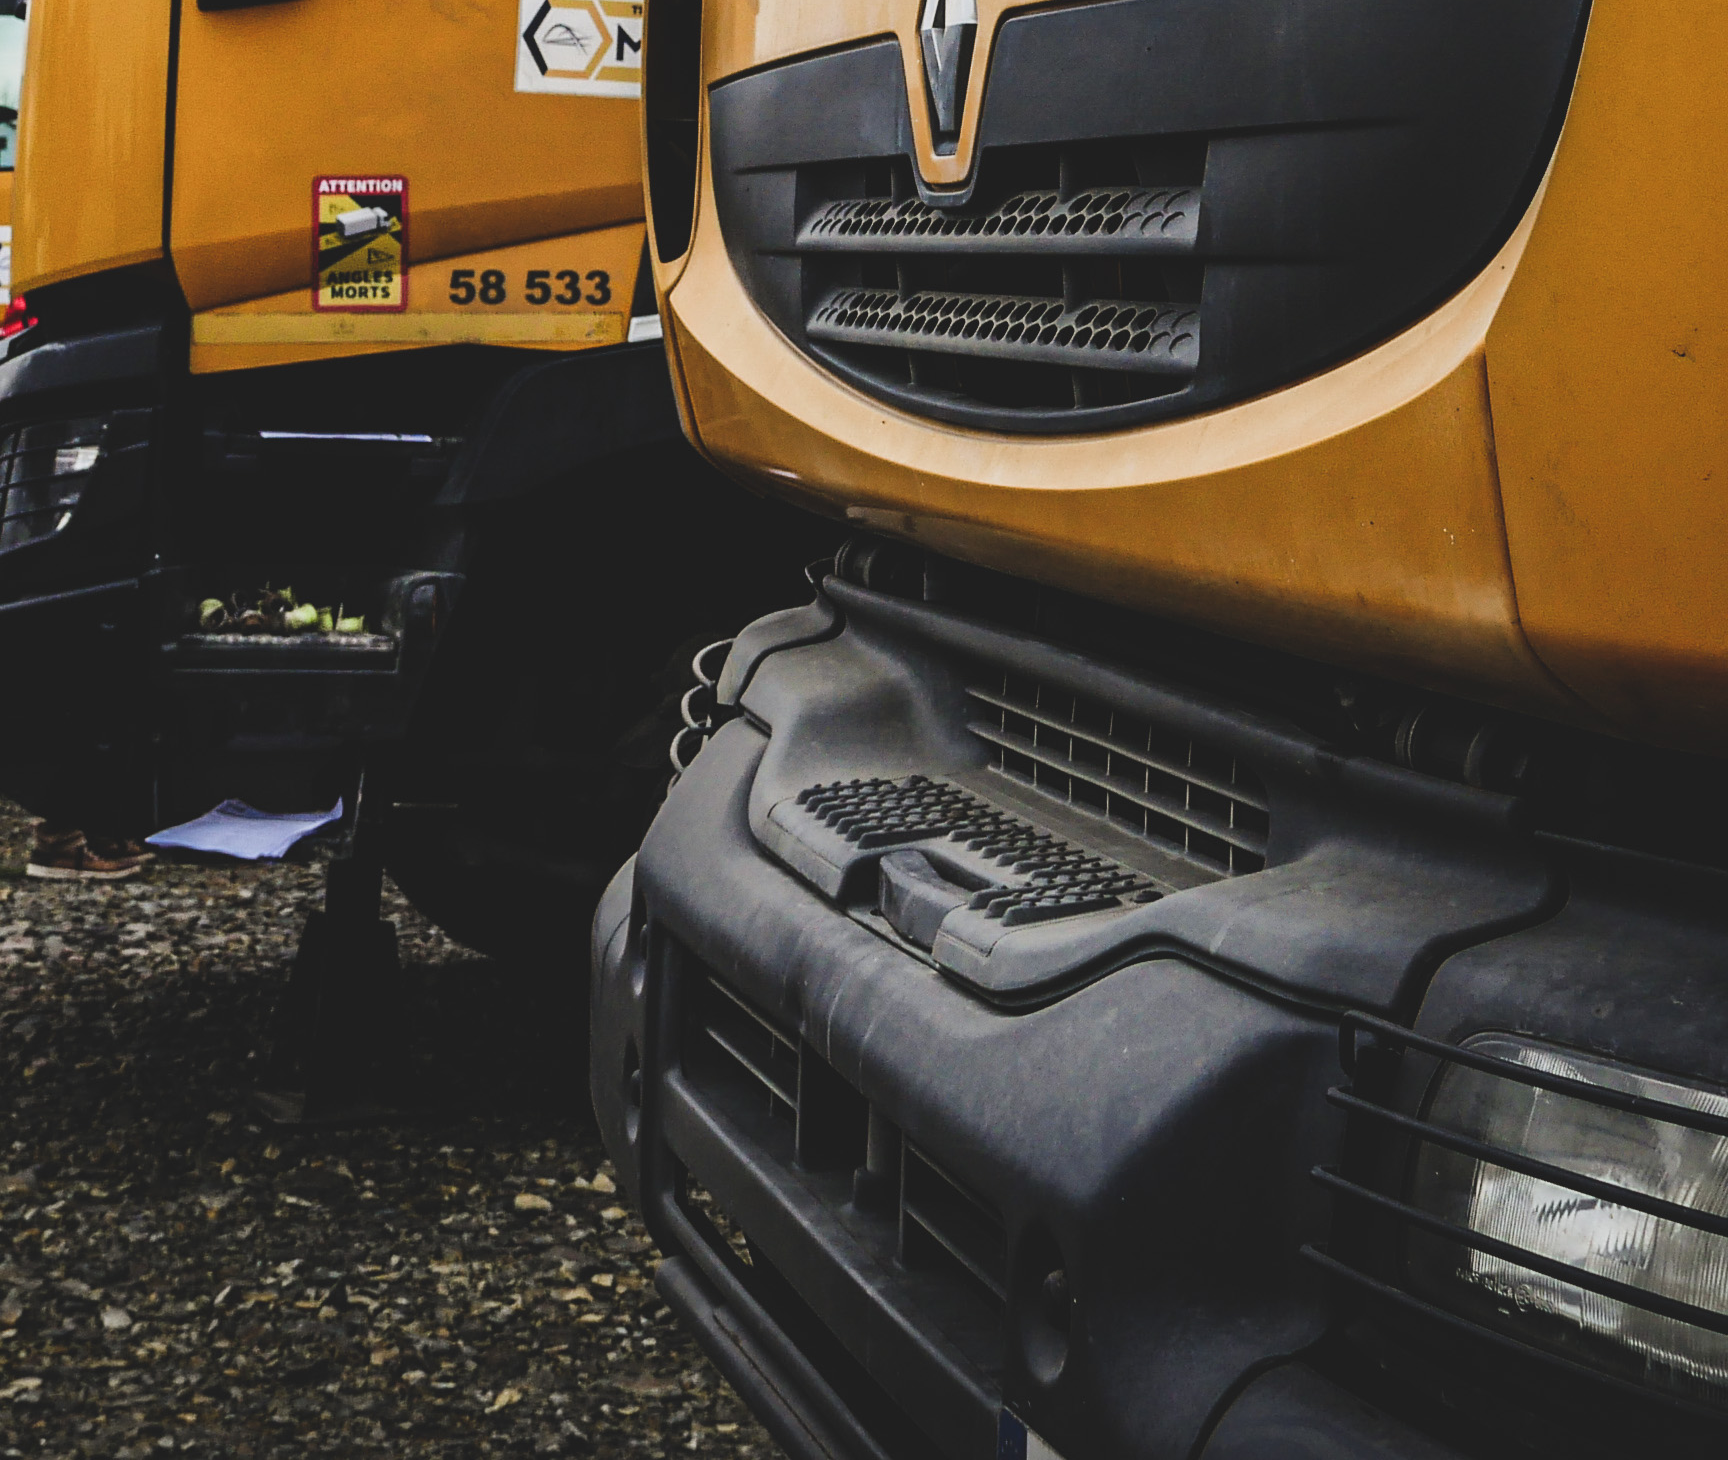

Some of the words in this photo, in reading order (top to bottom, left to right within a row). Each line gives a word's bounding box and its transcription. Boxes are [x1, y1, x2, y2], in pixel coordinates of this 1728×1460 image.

[319, 178, 403, 194] ATTENTION
[327, 270, 394, 285] ANGLES
[330, 285, 391, 300] MORTS
[448, 269, 506, 306] 58
[525, 270, 612, 306] 533
